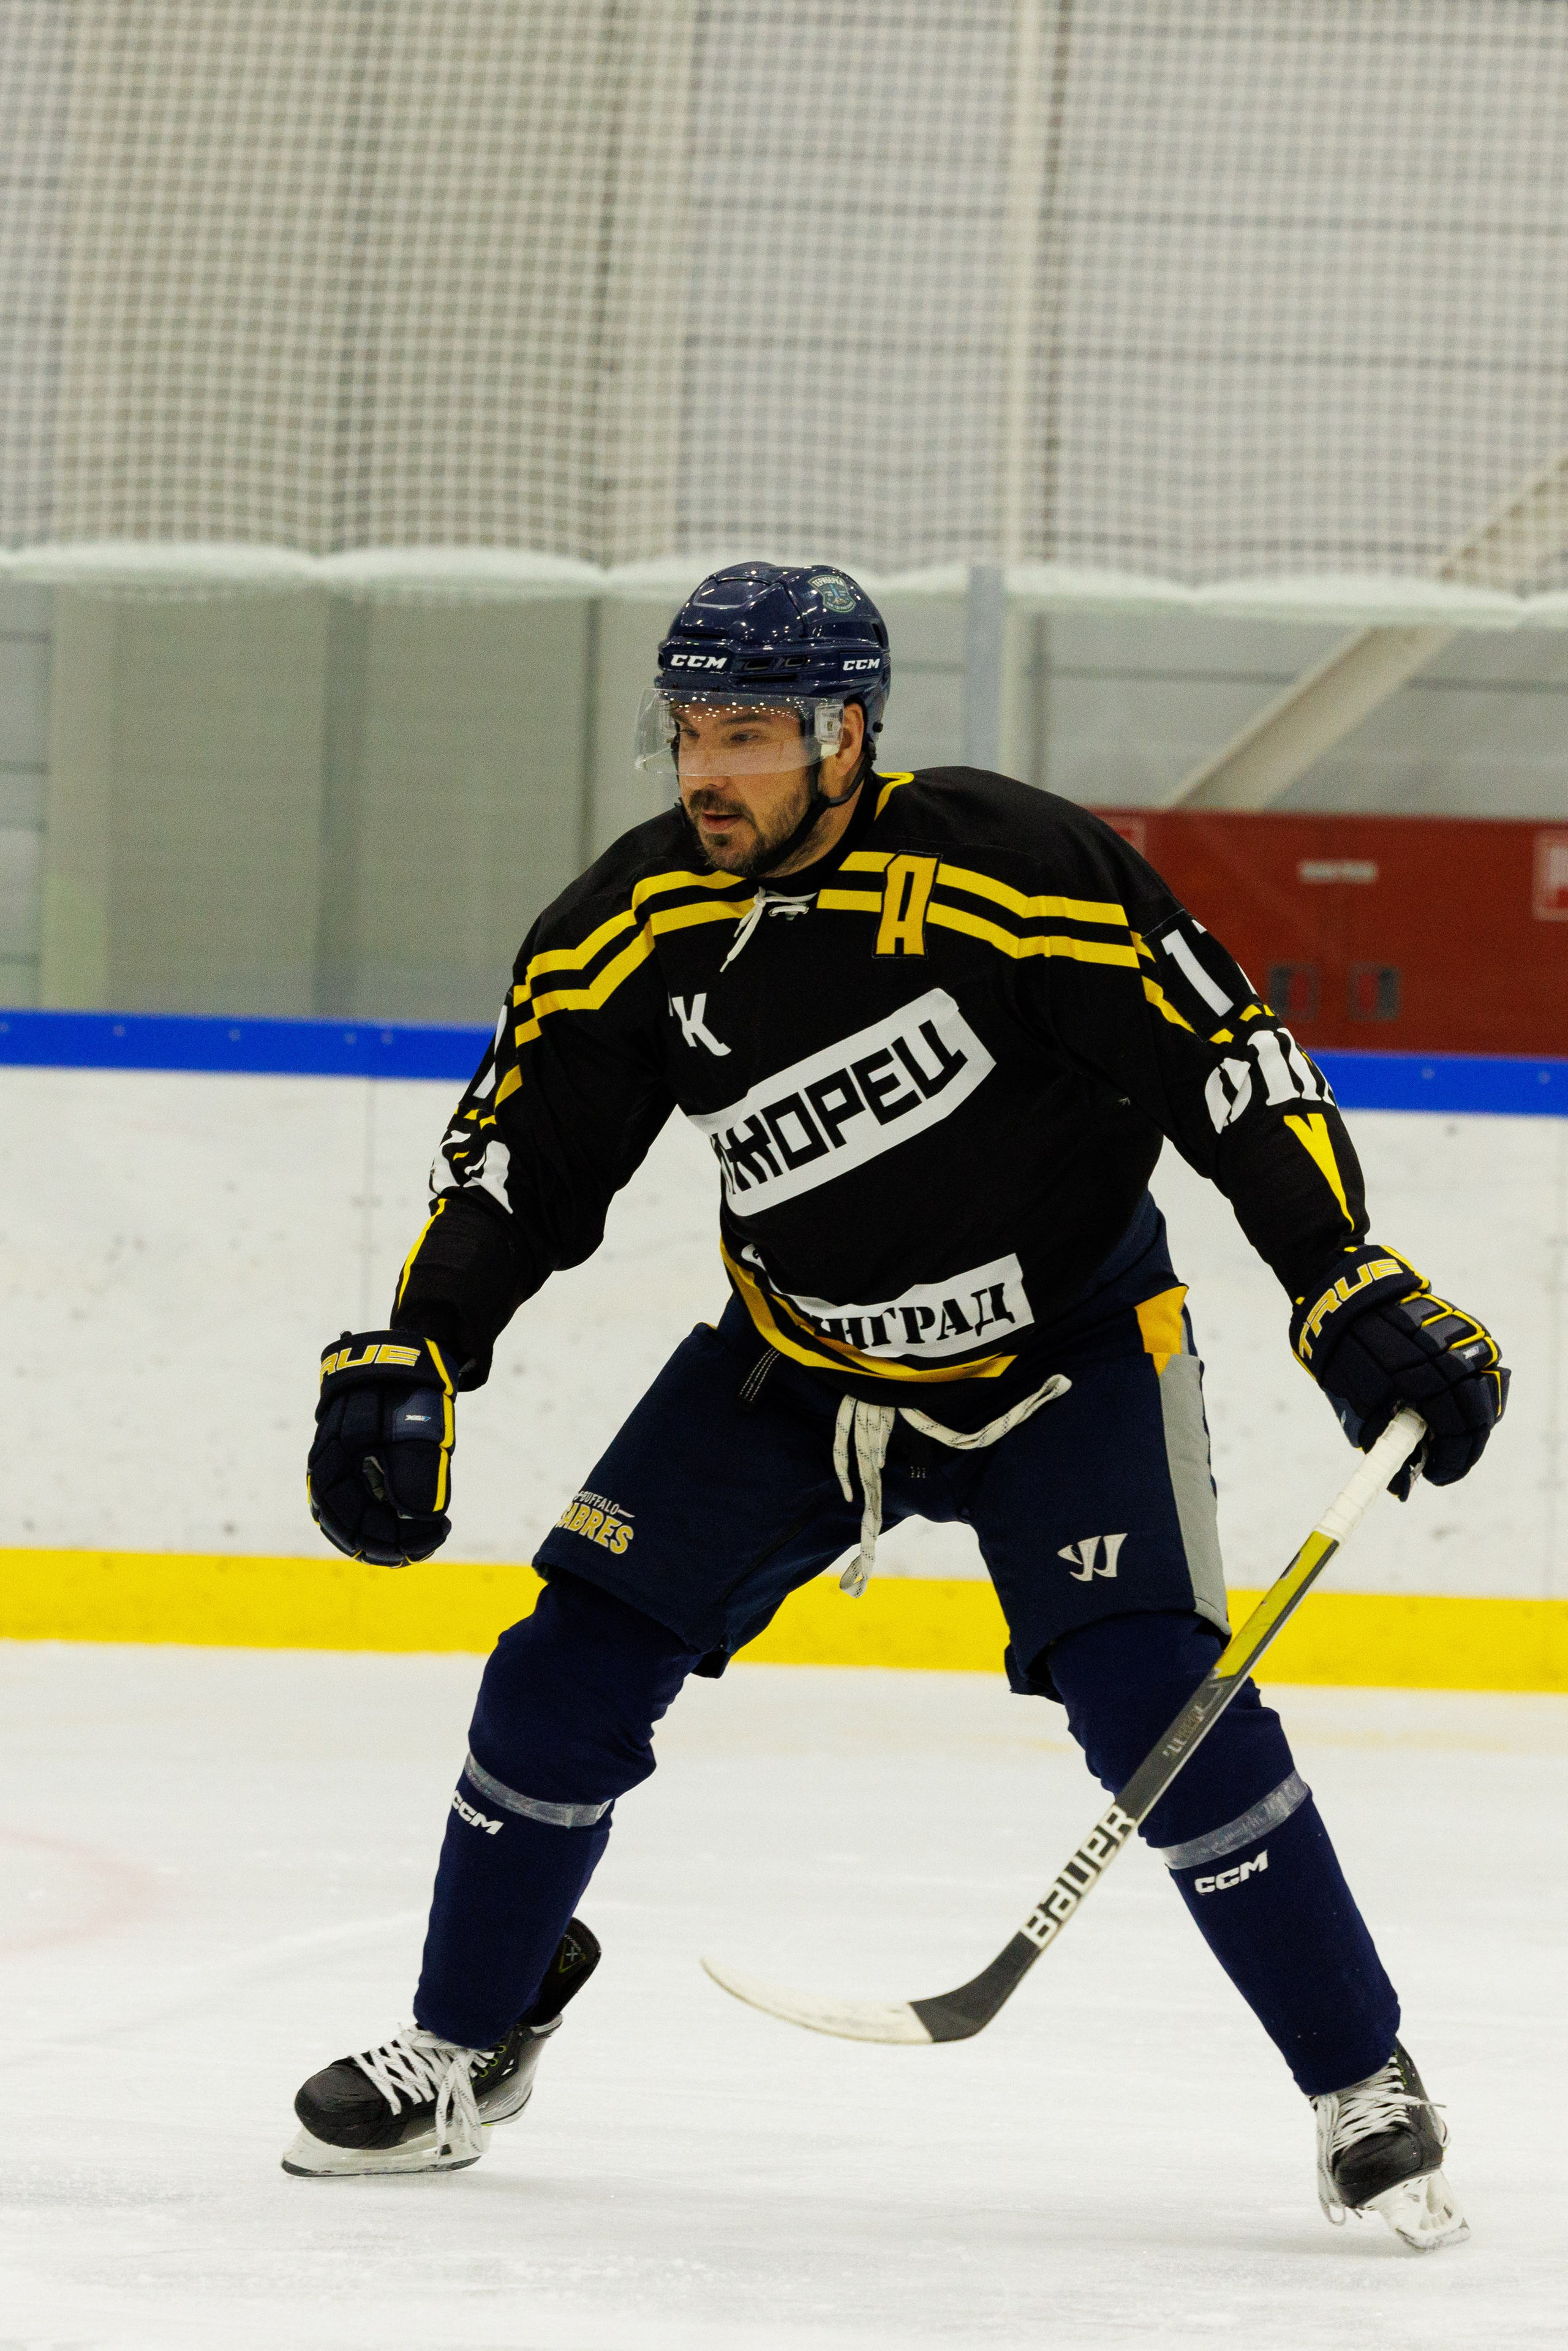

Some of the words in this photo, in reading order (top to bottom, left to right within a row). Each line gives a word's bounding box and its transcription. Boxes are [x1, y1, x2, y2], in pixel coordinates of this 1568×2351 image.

[671, 654, 728, 669] CCM
[843, 659, 880, 671] CCM
[812, 1282, 1015, 1350] НГРАД
[1298, 1259, 1403, 1359] TRUE
[320, 1344, 421, 1384] RUE
[555, 1502, 634, 1554] ABRES
[452, 1790, 503, 1835] CCM
[1022, 1803, 1137, 1947] BAUER
[1195, 1849, 1269, 1895] CCM
